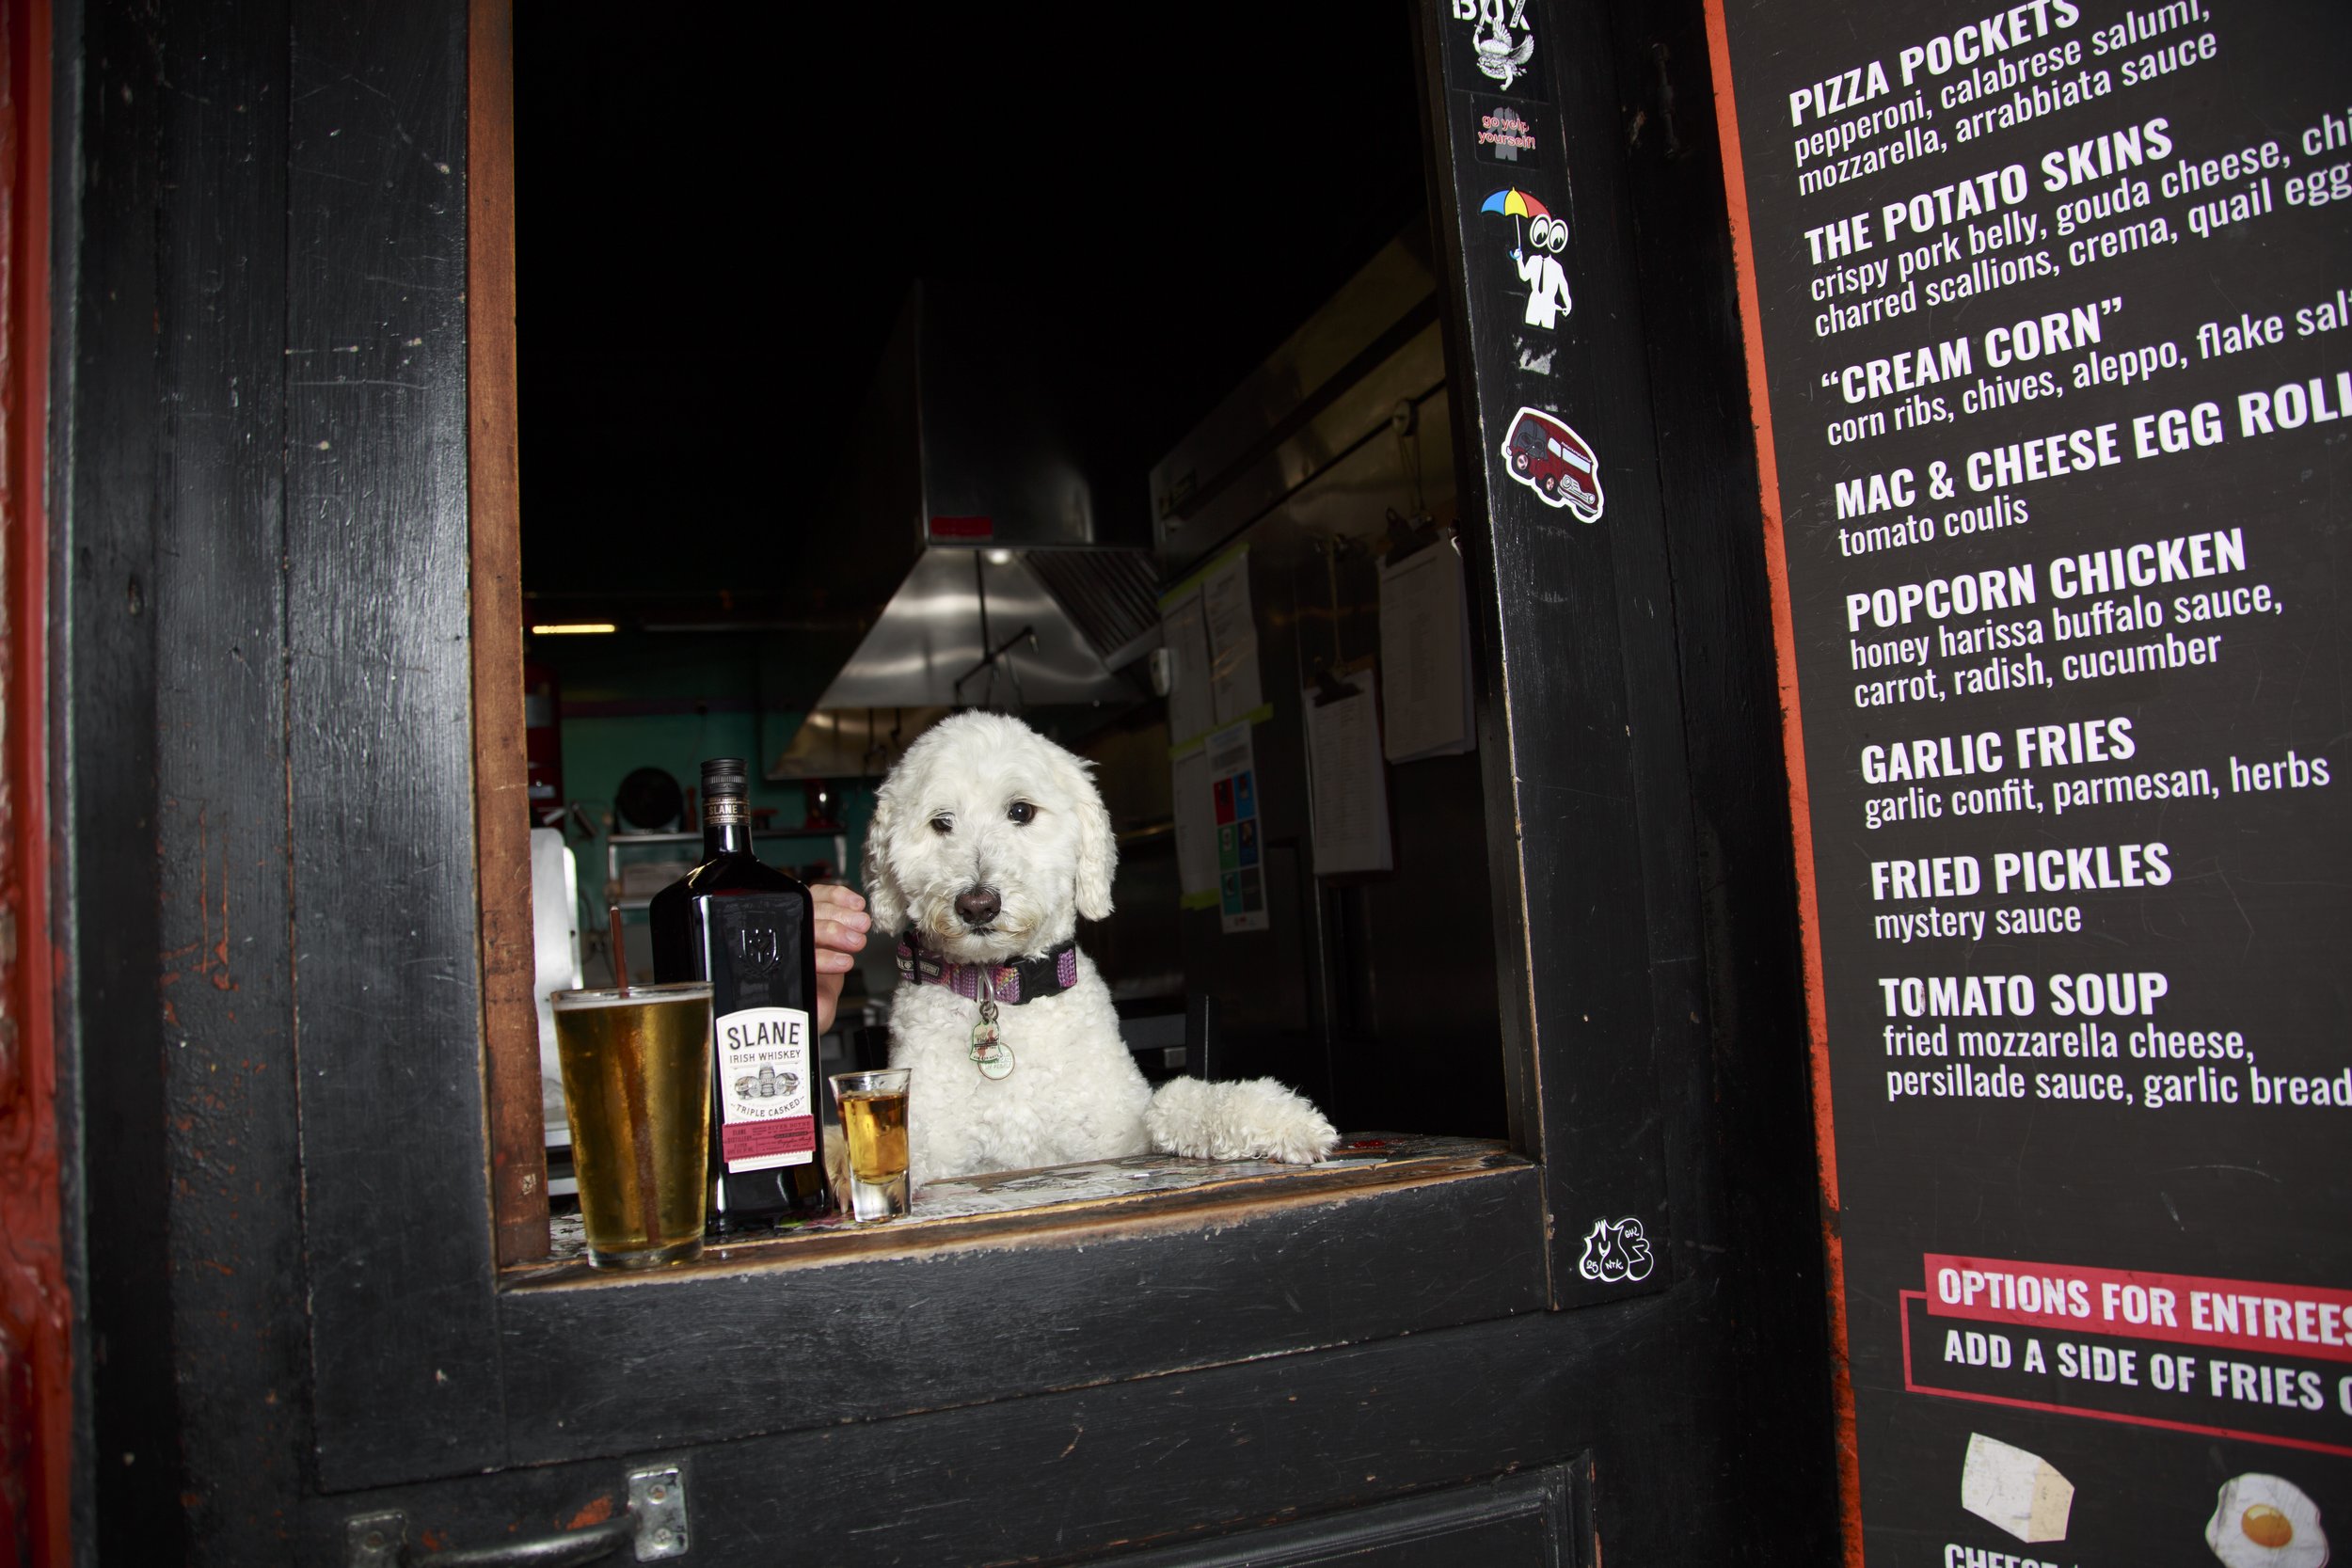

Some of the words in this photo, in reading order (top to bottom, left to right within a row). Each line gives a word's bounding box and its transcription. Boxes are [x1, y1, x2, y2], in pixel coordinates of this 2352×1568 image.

[1788, 60, 1890, 128] PIZZA
[1899, 0, 2080, 87] POCKETS
[1794, 89, 1932, 168] pepperoni,
[1940, 40, 2082, 110] calabrese
[2091, 0, 2210, 56] salumi,
[1478, 131, 1536, 150] yourself!
[1482, 115, 1500, 129] go
[1502, 118, 1530, 135] yelp
[1798, 126, 1947, 197] mozzarella,
[1955, 70, 2112, 143] arrabbiata
[2121, 33, 2217, 87] sauce
[1804, 212, 1873, 265] THE
[1882, 164, 2028, 243] POTATO
[2041, 118, 2172, 193] SKINS
[1811, 258, 1889, 302] crispy
[1898, 231, 1963, 283] pork
[1967, 210, 2047, 256] belly,
[2056, 177, 2151, 236] gouda
[2161, 141, 2291, 198] cheese,
[1815, 280, 1917, 338] charred
[1925, 250, 2060, 307] scallions,
[2069, 217, 2178, 267] crema,
[2187, 177, 2272, 239] quail
[1827, 411, 1886, 446] corn
[1894, 393, 1955, 431] ribs,
[1963, 371, 2063, 415] chives,
[2072, 341, 2188, 389] aleppo,
[2196, 313, 2284, 359] flake
[2296, 290, 2352, 337] sal
[1835, 467, 1916, 520] MAC
[1928, 460, 1955, 500] &
[1966, 422, 2122, 492] CHEESE
[2132, 402, 2223, 460] EGG
[1837, 515, 1935, 557] tomato
[1944, 494, 2029, 537] coulis
[1846, 563, 2036, 633] POPCORN
[2049, 527, 2246, 599] CHICKEN
[1850, 636, 1930, 671] honey
[1938, 618, 2044, 657] harissa
[2052, 594, 2163, 641] buffalo
[2173, 584, 2282, 624] sauce,
[1854, 668, 1946, 708] carrot,
[1953, 652, 2054, 695] radish,
[2062, 632, 2222, 681] cucumber
[1861, 731, 2003, 784] GARLIC
[2015, 716, 2136, 769] FRIES
[708, 803, 738, 816] SLANE
[1865, 786, 1943, 830] garlic
[1951, 778, 2043, 816] confit,
[2052, 768, 2219, 816] parmesan,
[2230, 750, 2330, 793] herbs
[1870, 855, 1980, 901] FRIED
[1994, 842, 2172, 895] PICKLES
[1874, 906, 1986, 944] mystery
[1994, 906, 2082, 935] sauce
[1878, 974, 2035, 1018] TOMATO
[2049, 972, 2169, 1017] SOUP
[727, 1021, 801, 1051] SLANE
[729, 1053, 756, 1064] IRISH
[758, 1049, 802, 1061] WHISKEY
[1883, 1022, 1948, 1057] fried
[1958, 1022, 2119, 1058] mozzarella
[2129, 1022, 2254, 1065] cheese,
[737, 1103, 766, 1117] TRIPLE
[768, 1098, 801, 1117] CASKED
[1886, 1063, 2026, 1102] persillade
[2035, 1072, 2134, 1106] sauce,
[2143, 1066, 2238, 1109] garlic
[2249, 1066, 2352, 1107] bread
[1937, 1267, 2091, 1319] OPTIONS
[2101, 1282, 2178, 1328] FOR
[1944, 1329, 2011, 1369] ADD
[2024, 1338, 2046, 1374] A
[2057, 1342, 2138, 1386] SIDE
[2150, 1353, 2195, 1393] OF
[2209, 1360, 2324, 1410] FRIES
